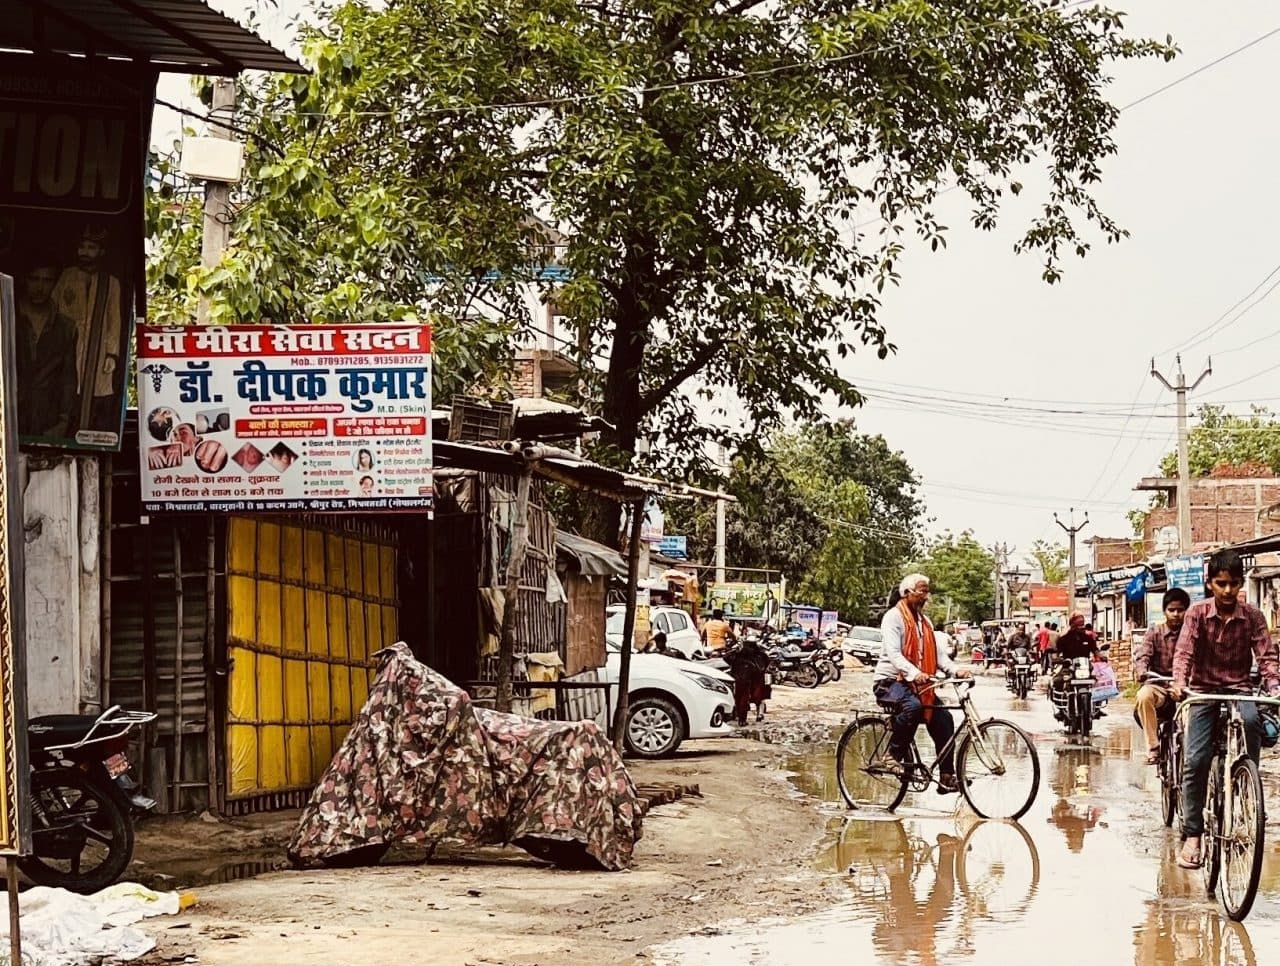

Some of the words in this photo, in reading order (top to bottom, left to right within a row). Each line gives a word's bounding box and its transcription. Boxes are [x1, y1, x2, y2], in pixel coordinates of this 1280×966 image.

[192, 326, 262, 353] मीरा
[268, 325, 337, 352] सेवा
[341, 327, 423, 351] सदन
[175, 361, 223, 403] डॉ.
[233, 360, 330, 402] दीपक
[335, 367, 428, 414] कुमार
[378, 405, 397, 413] M.D.
[400, 405, 426, 414] (Skin)
[153, 474, 173, 485] रोगी
[175, 473, 200, 484] देखने
[202, 475, 214, 485] का
[248, 474, 281, 486] शुक्रवार
[152, 489, 162, 498] 10
[164, 487, 179, 498] बजे
[181, 487, 199, 497] दिन
[201, 487, 210, 497] से
[212, 488, 231, 497] शाम
[234, 488, 247, 497] 05
[249, 486, 265, 497] बजे
[267, 487, 285, 496] तक
